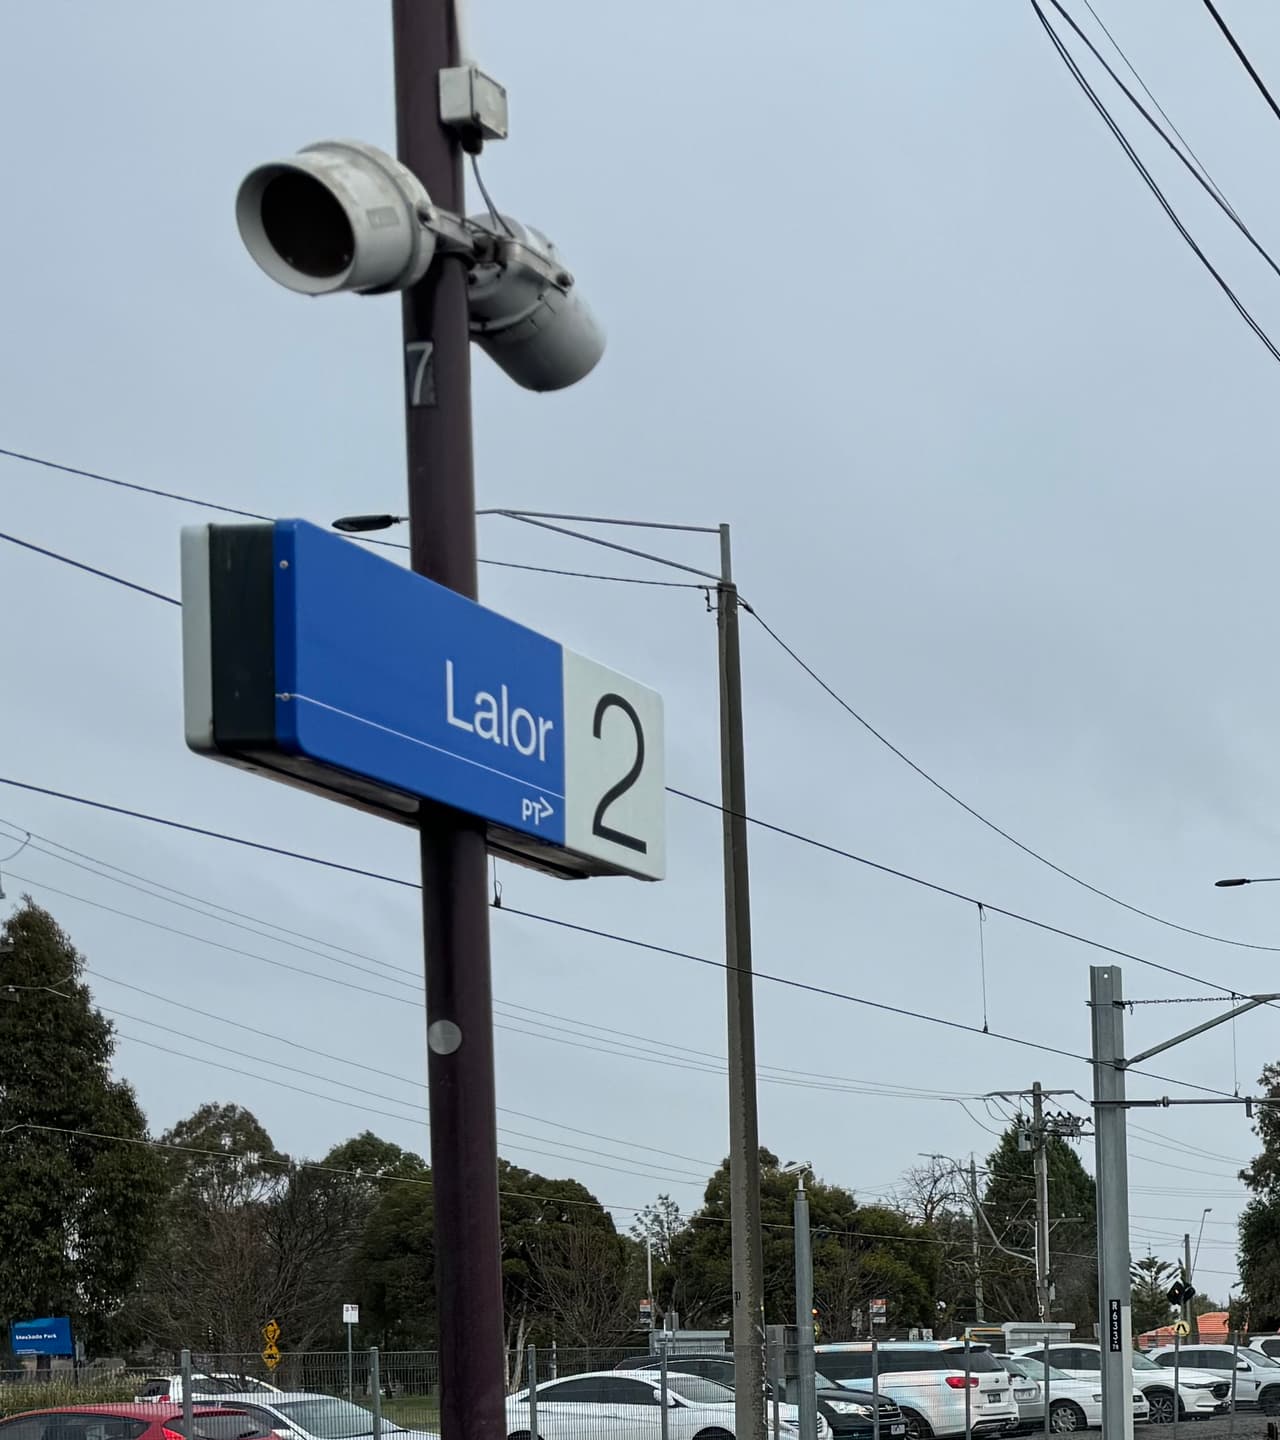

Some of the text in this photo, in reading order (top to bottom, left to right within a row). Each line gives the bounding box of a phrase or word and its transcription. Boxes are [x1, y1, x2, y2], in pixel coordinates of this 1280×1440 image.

[405, 341, 434, 406] 7
[445, 660, 553, 763] Lalor
[592, 693, 647, 855] 2
